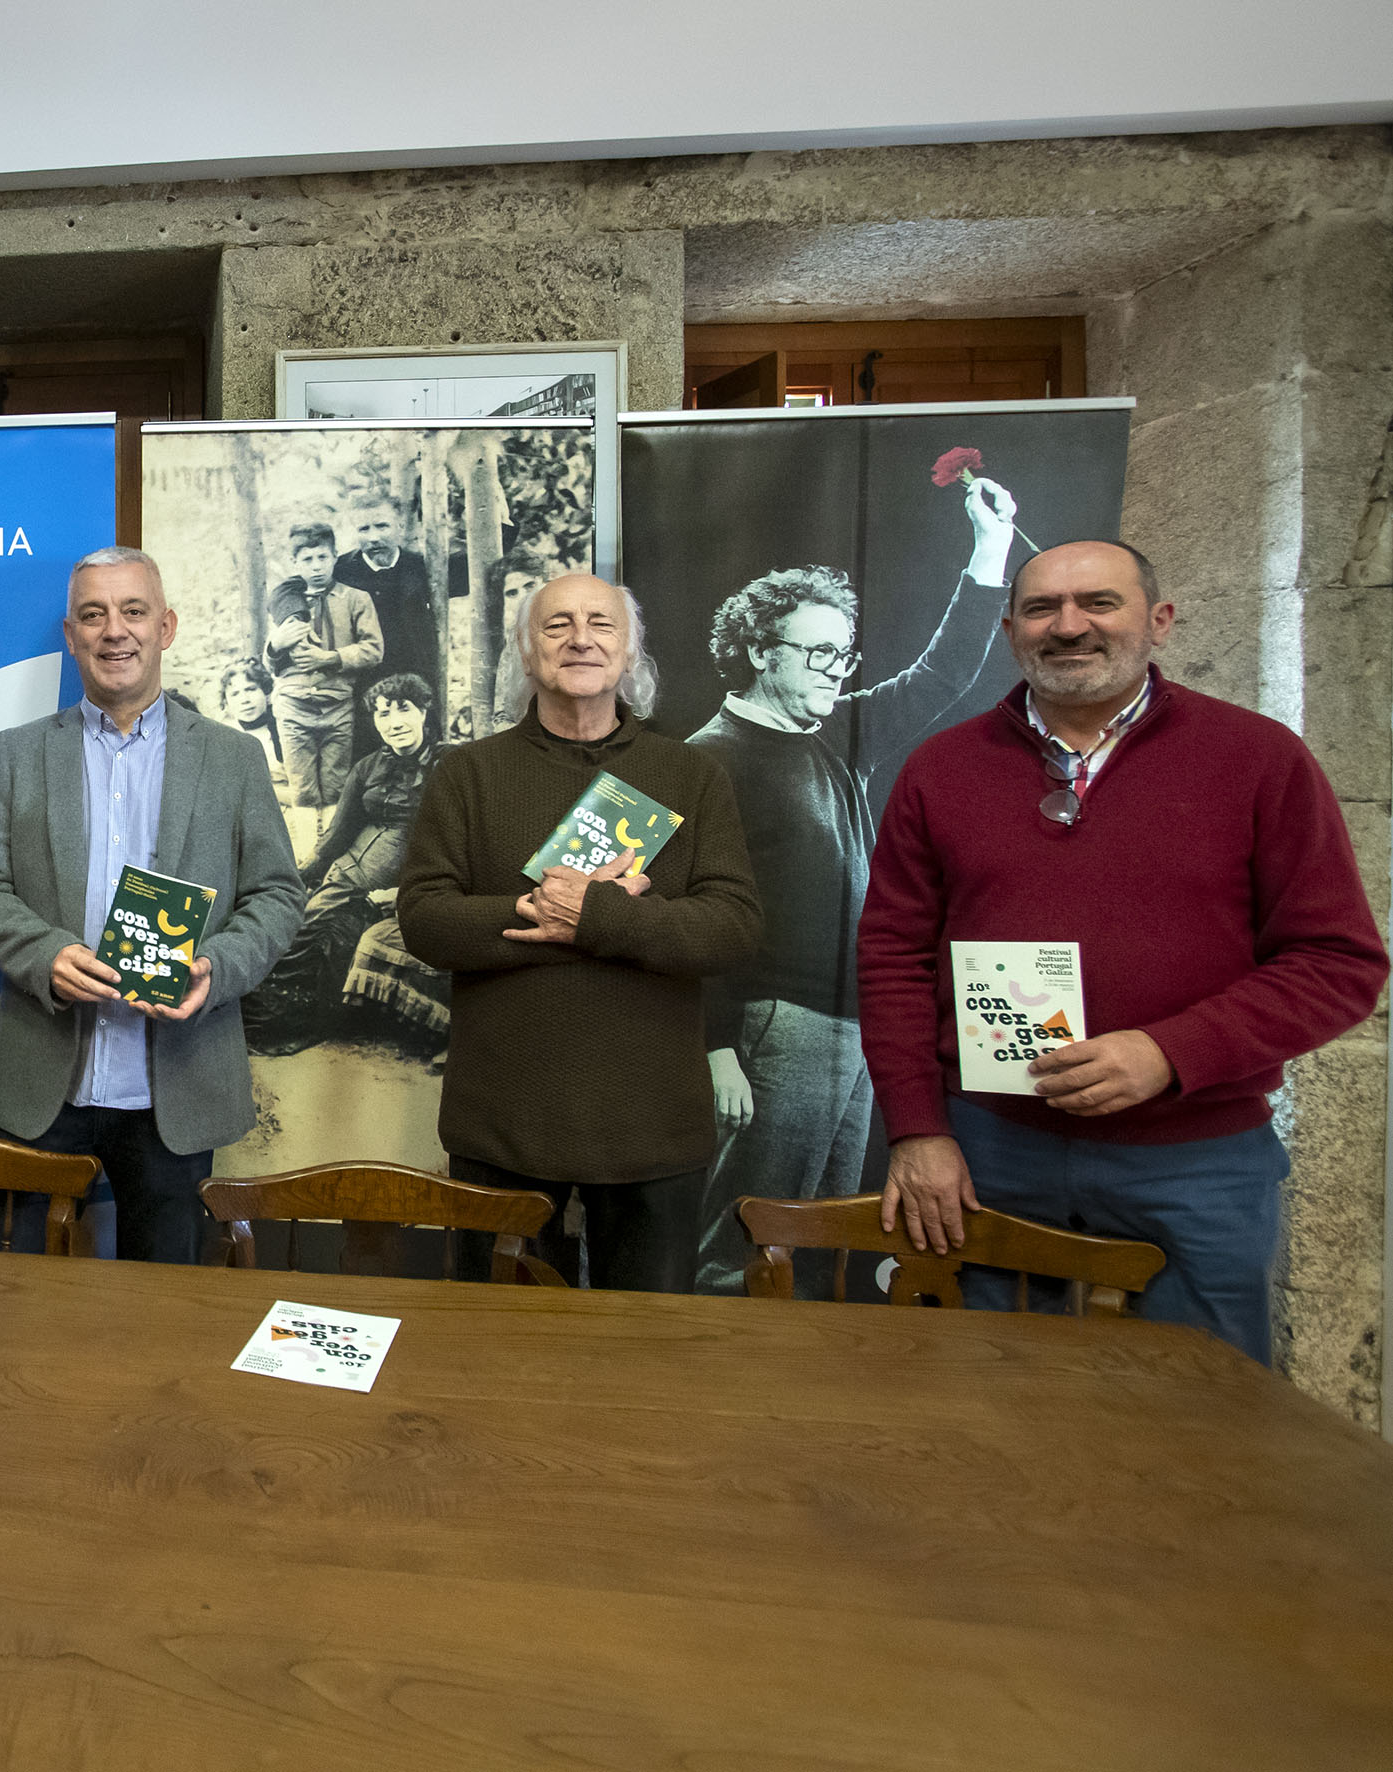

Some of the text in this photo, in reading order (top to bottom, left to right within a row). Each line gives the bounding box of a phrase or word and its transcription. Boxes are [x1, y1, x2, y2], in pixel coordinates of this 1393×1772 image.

[573, 806, 607, 833] con
[577, 822, 612, 850] ver
[114, 908, 150, 930] con
[122, 924, 159, 944] ver
[144, 944, 188, 962] gên
[119, 955, 172, 976] cias
[966, 997, 1012, 1010] con
[980, 1012, 1028, 1026] ver
[1016, 1024, 1073, 1046] gên
[292, 1320, 358, 1334] cias
[310, 1340, 358, 1352] ver
[323, 1348, 372, 1360] con
